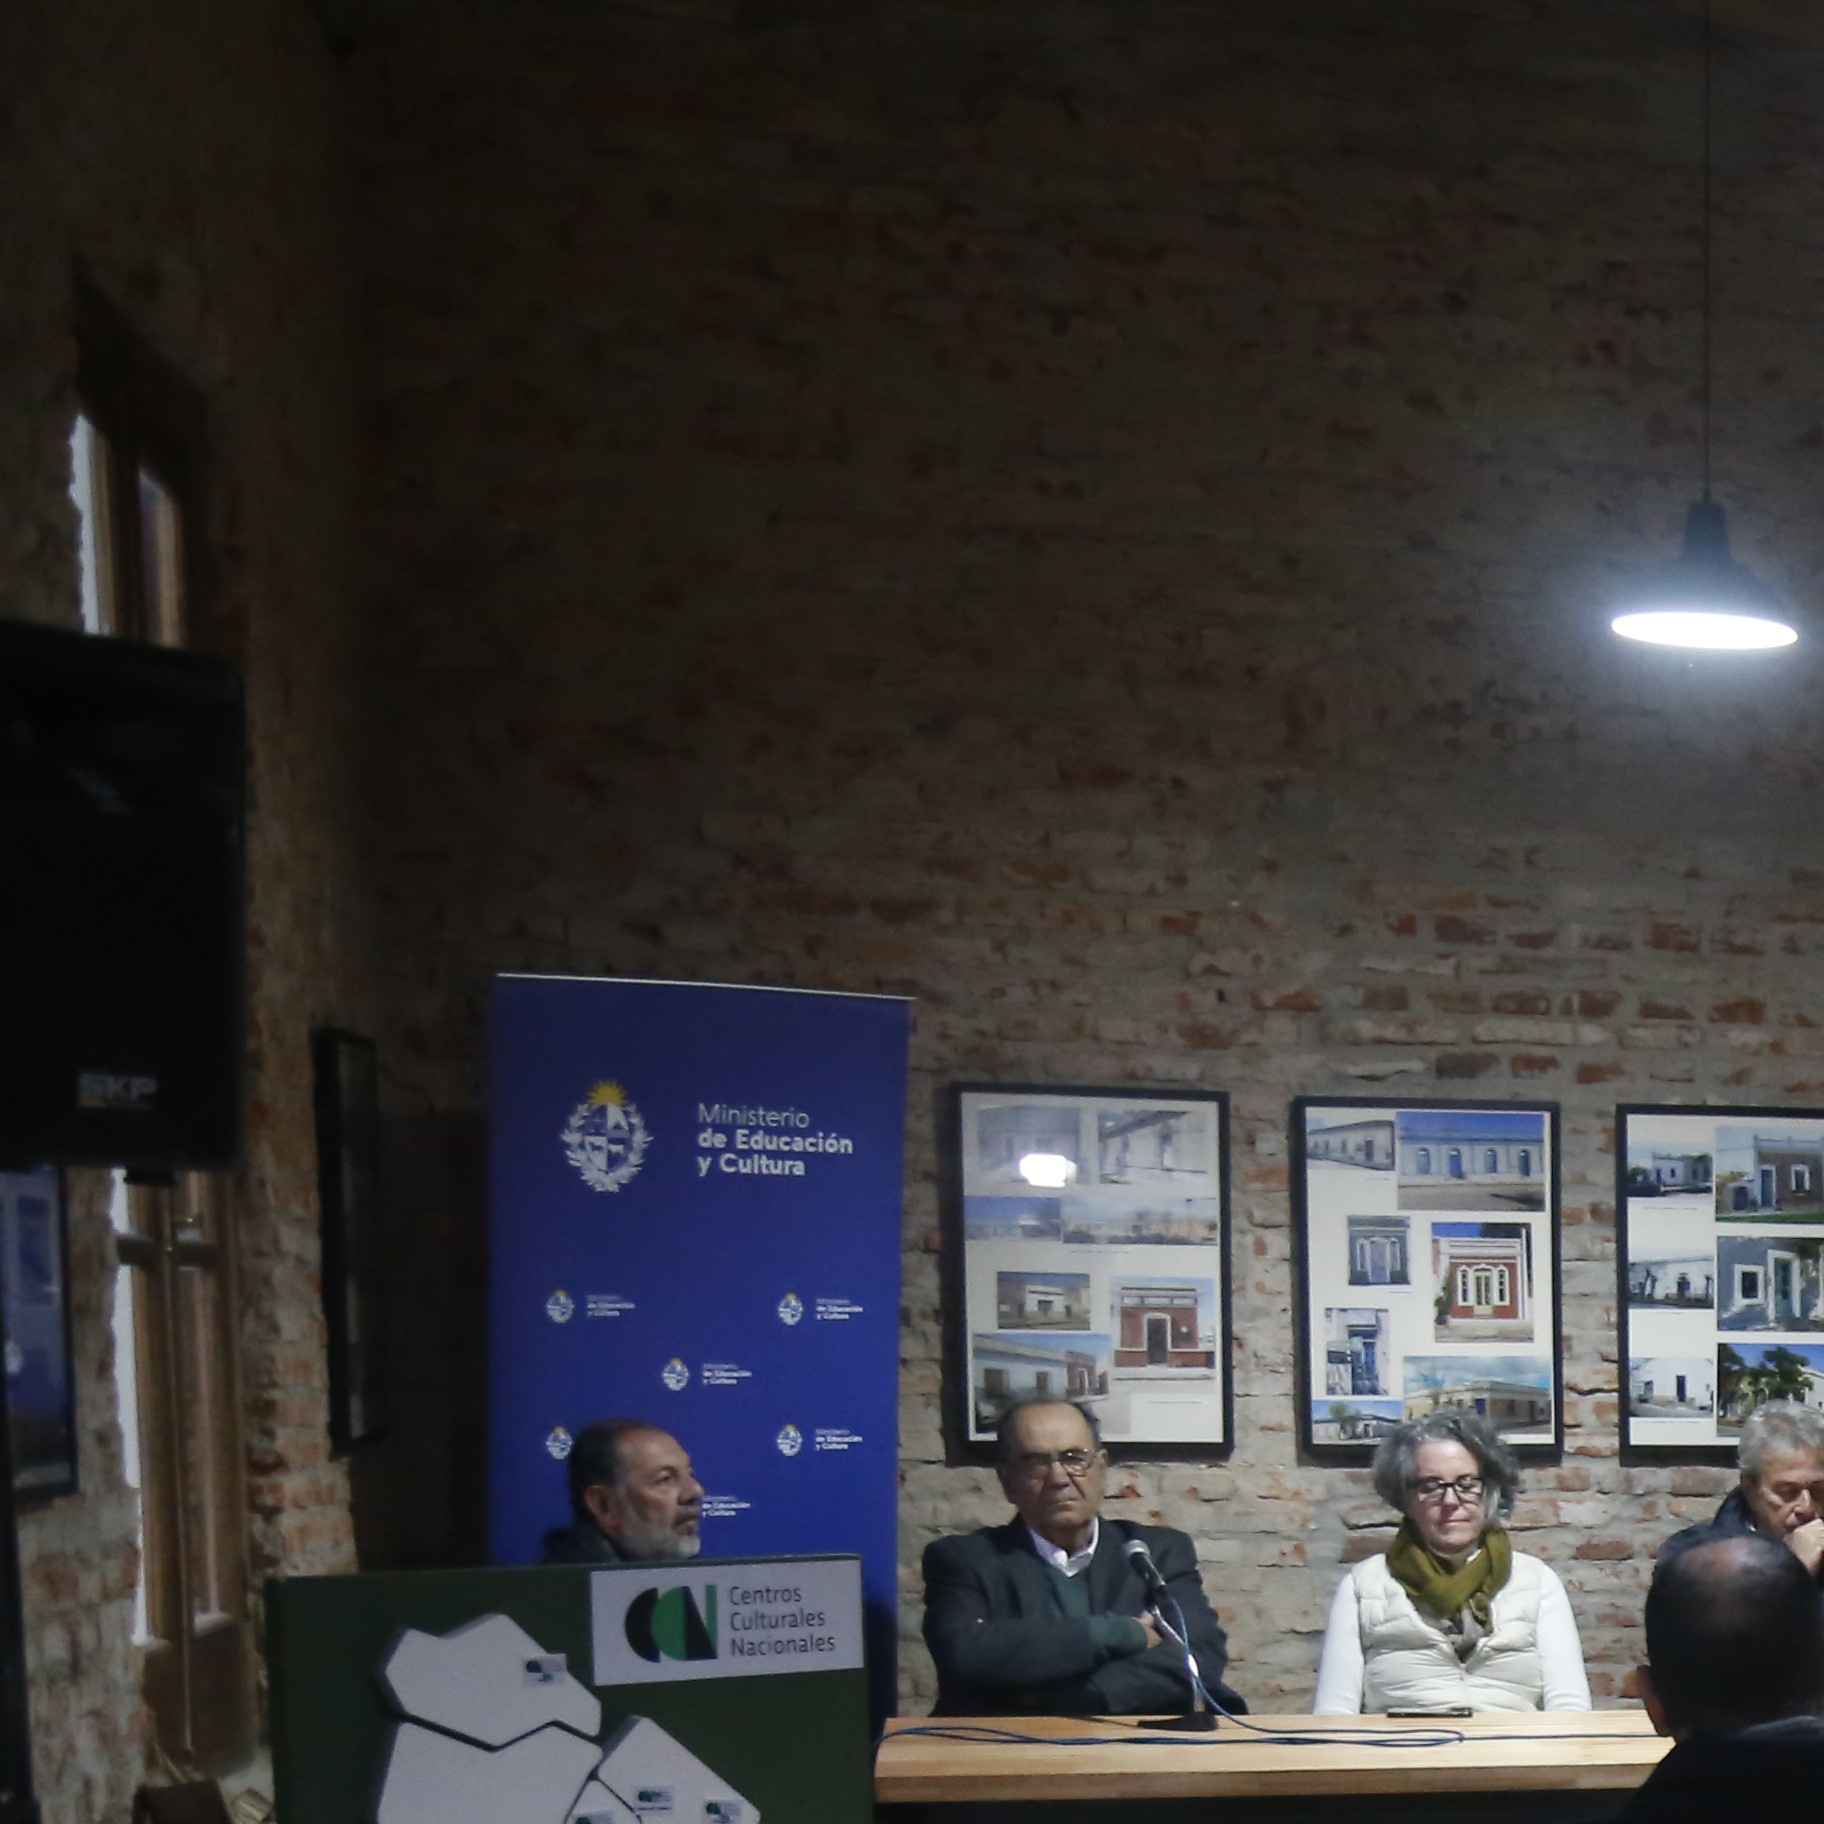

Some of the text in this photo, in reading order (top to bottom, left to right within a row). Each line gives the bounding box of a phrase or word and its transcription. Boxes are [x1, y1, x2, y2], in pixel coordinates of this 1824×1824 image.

[79, 1072, 159, 1102] SKP
[698, 1103, 810, 1128] Ministerio
[698, 1128, 854, 1154] de Educación
[697, 1153, 806, 1177] y Cultura
[729, 1585, 802, 1606] Centros
[730, 1608, 825, 1631] Culturales
[731, 1633, 836, 1657] Nacionales
